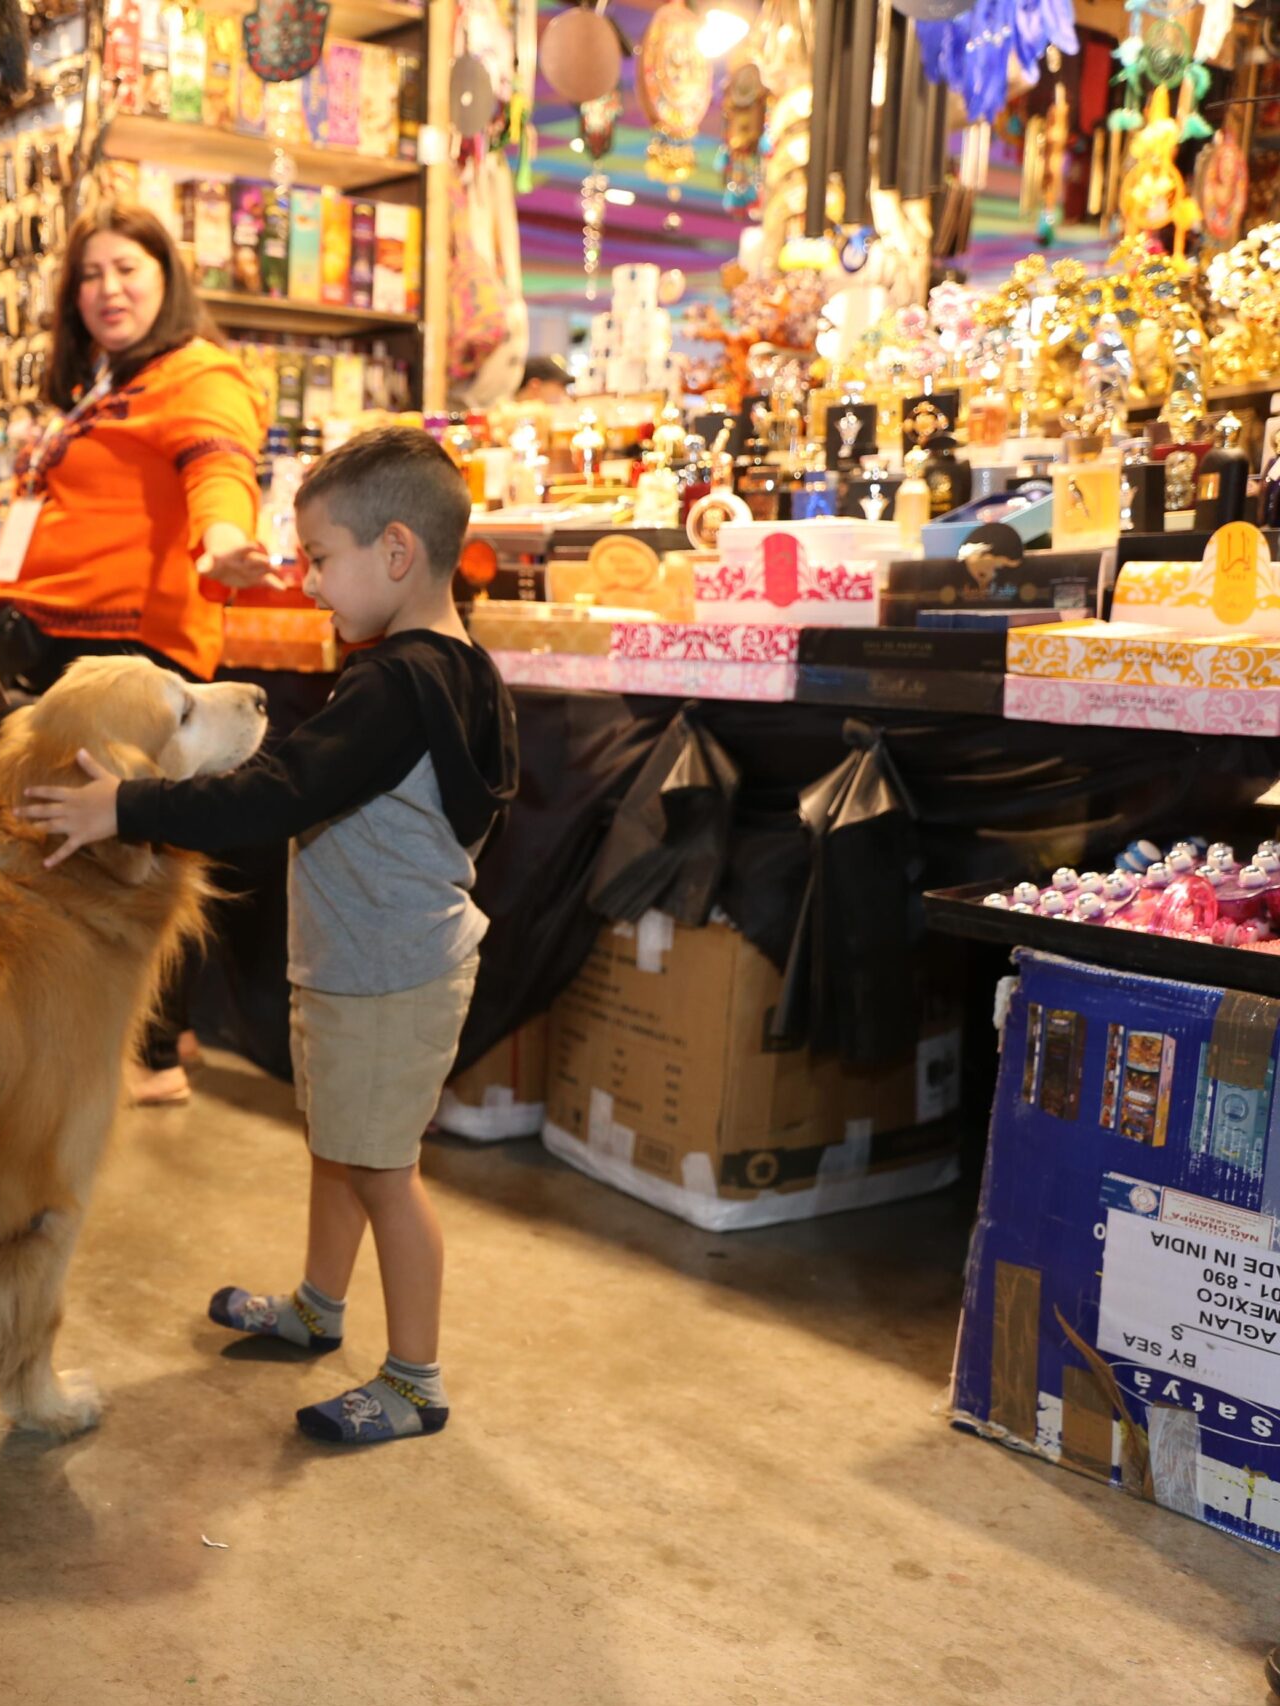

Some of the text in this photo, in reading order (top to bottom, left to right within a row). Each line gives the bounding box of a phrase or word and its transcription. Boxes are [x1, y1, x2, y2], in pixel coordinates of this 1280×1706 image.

[1171, 1212, 1227, 1233] CHAMPA
[1150, 1232, 1207, 1260] INDIA
[1230, 1229, 1259, 1243] NAG
[1214, 1249, 1236, 1268] IN
[1203, 1268, 1238, 1290] 890
[1197, 1288, 1280, 1324] MEXICO
[1123, 1332, 1197, 1369] BY SEA
